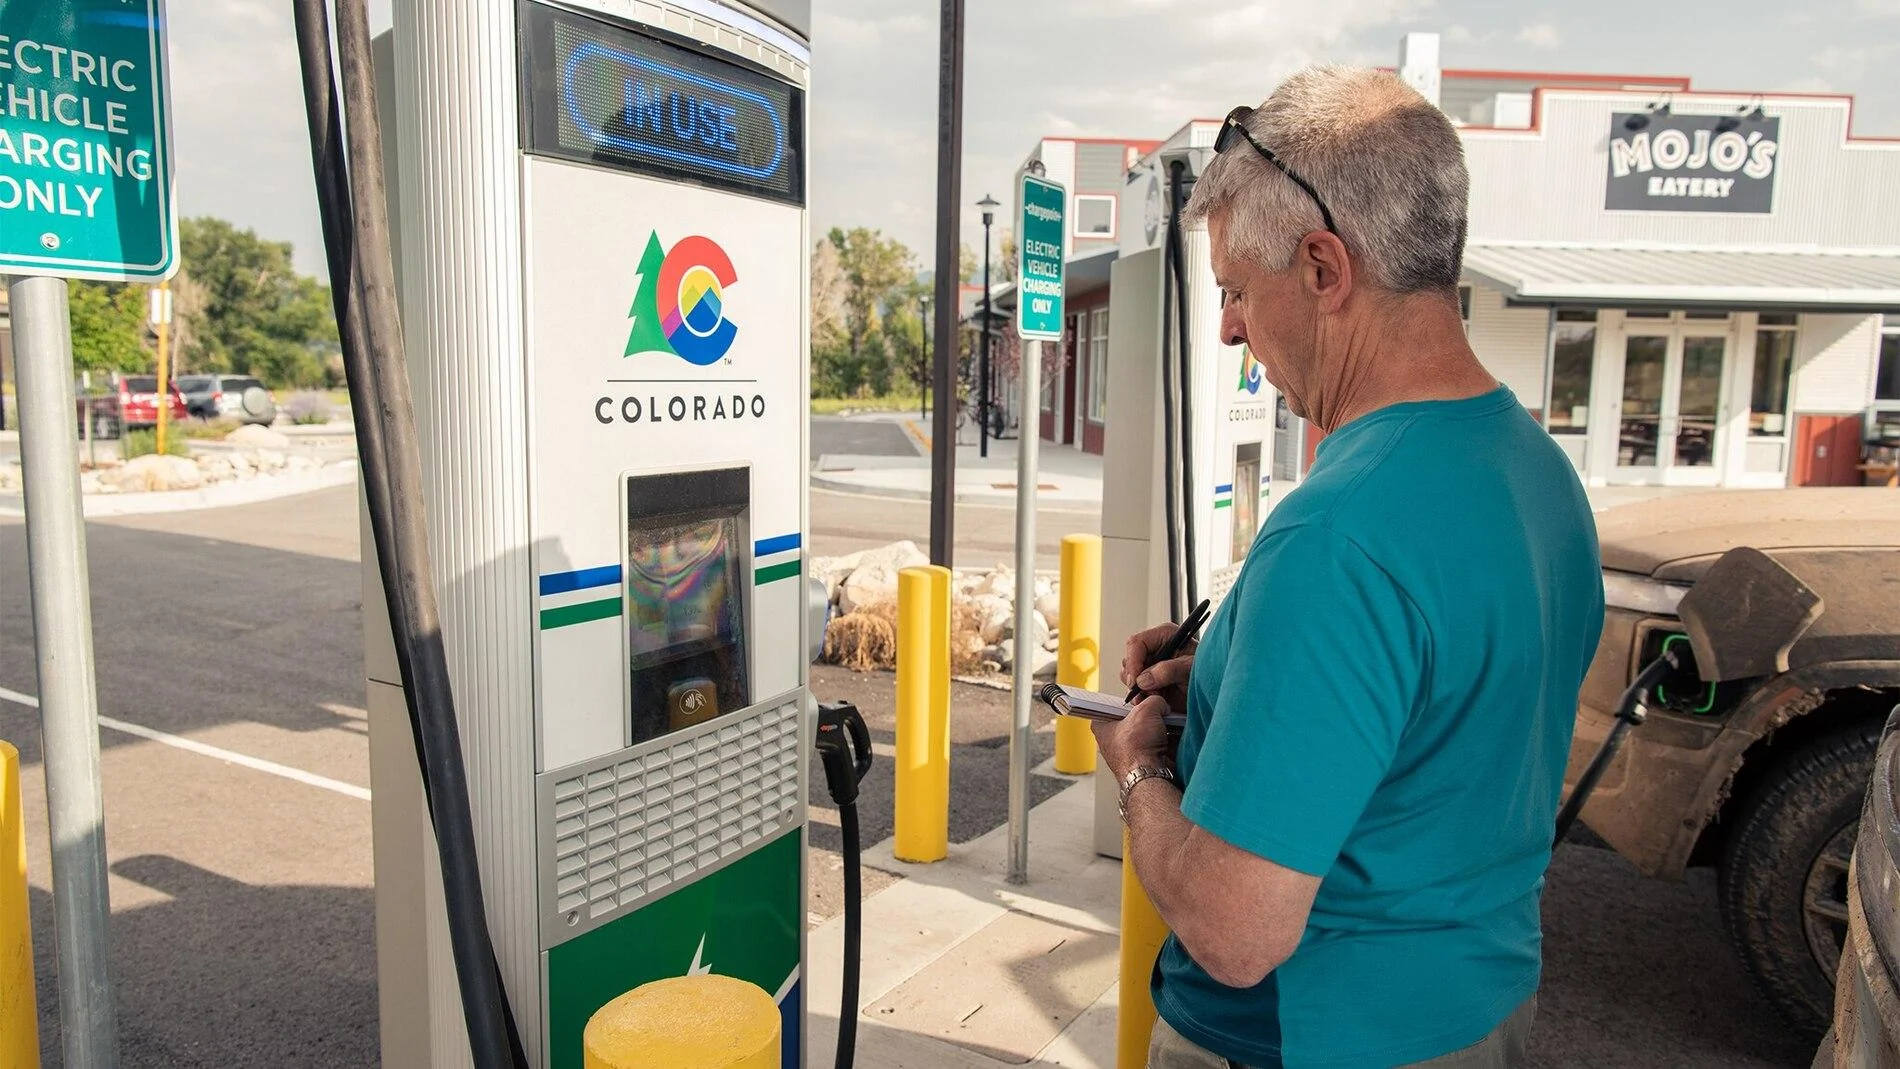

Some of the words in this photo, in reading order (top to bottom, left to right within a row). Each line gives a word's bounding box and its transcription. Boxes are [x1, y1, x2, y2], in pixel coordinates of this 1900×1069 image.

[0, 82, 129, 135] HICLE
[625, 78, 661, 133] IN
[672, 91, 737, 150] USE
[1611, 129, 1778, 179] MOJO'S
[0, 175, 103, 218] ONLY
[1647, 176, 1735, 197] EATERY
[1026, 240, 1060, 259] ELECTRIC
[1028, 260, 1058, 277] VEHICLE
[1023, 277, 1062, 298] CHARGING
[1032, 298, 1052, 314] ONLY
[594, 394, 766, 425] COLORADO
